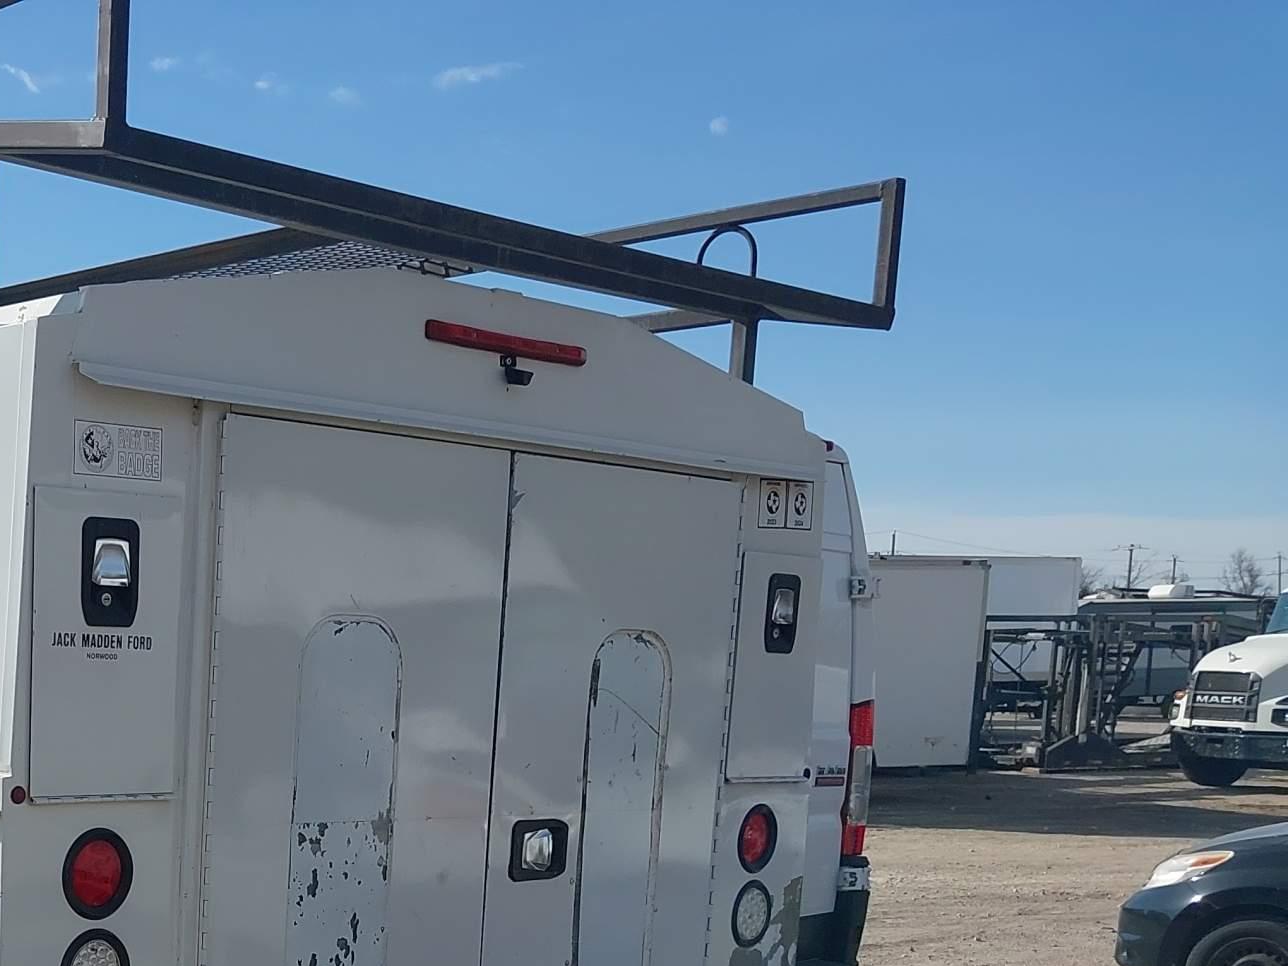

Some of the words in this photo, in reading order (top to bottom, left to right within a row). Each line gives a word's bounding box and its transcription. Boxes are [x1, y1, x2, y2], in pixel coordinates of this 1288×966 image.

[117, 451, 160, 479] BADGE
[51, 632, 76, 647] JACK
[81, 633, 122, 649] MADDEN
[127, 635, 152, 650] FORD
[86, 652, 118, 660] NORWOOD
[1195, 695, 1245, 704] MACK
